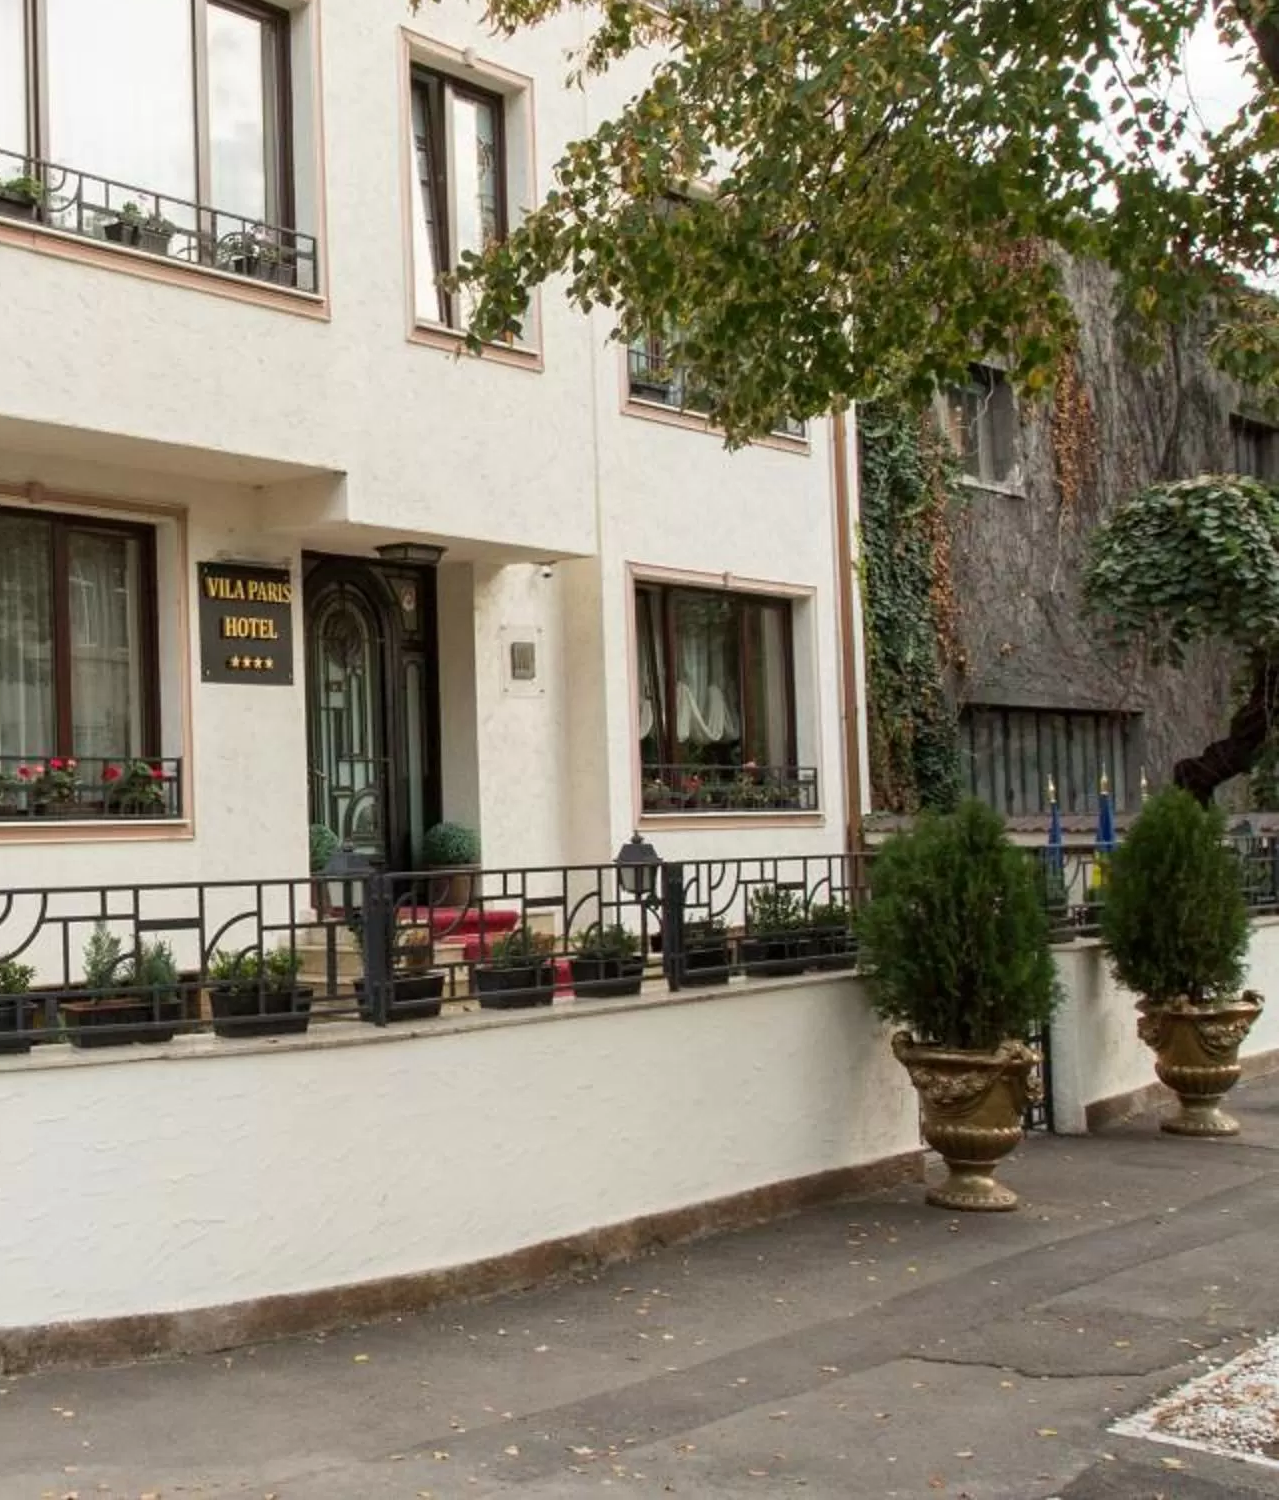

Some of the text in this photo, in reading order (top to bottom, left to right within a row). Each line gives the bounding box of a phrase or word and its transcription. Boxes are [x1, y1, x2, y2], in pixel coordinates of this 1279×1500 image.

[207, 577, 293, 603] VILA PARIS
[225, 616, 277, 639] HOTEL
